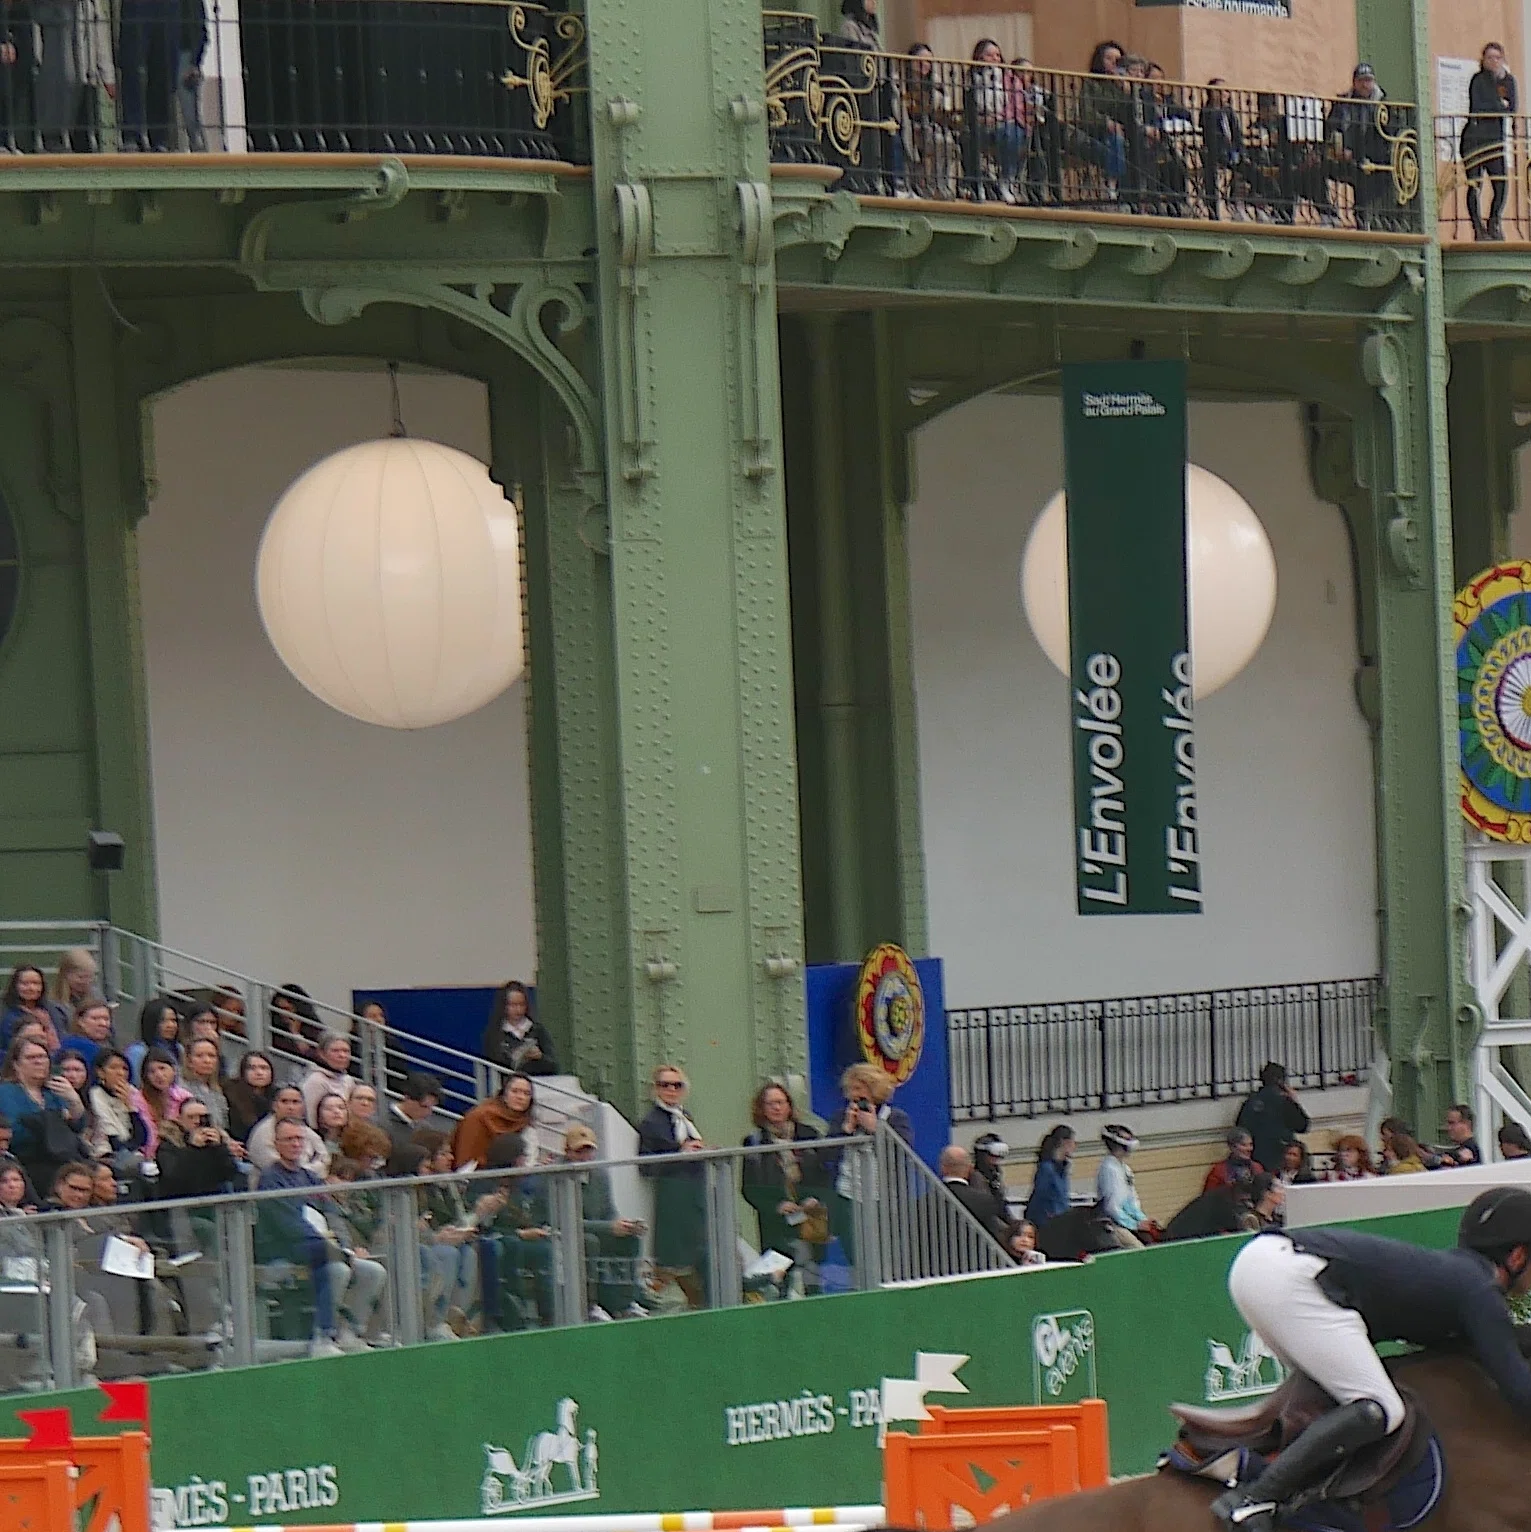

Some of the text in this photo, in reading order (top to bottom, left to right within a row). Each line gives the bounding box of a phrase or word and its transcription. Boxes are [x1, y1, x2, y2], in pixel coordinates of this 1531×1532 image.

[1085, 393, 1153, 405] Saut Hermès
[1085, 404, 1166, 417] au Grand Palais
[1076, 652, 1128, 905] L'Envolée
[725, 1388, 836, 1446] HERMÈS
[247, 1464, 340, 1516] PARIS
